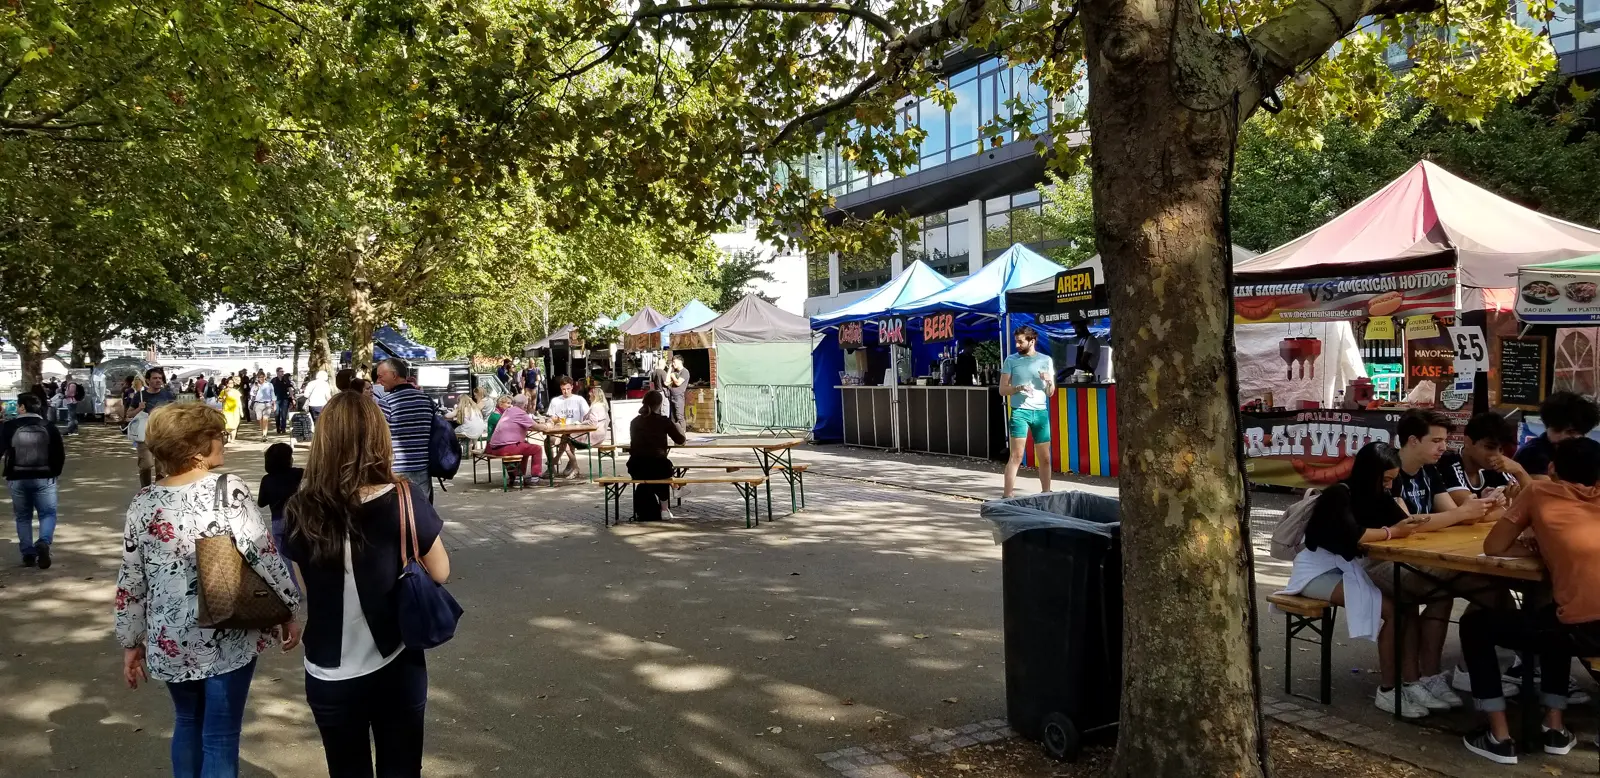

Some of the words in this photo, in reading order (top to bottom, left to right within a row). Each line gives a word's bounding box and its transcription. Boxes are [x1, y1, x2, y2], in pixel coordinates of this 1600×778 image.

[1057, 273, 1092, 294] AREPA
[1255, 283, 1305, 297] SAUSAGE
[1307, 285, 1335, 302] VS
[1337, 276, 1397, 293] AMERICAN
[1400, 272, 1449, 290] HOTDOG
[1045, 314, 1060, 322] GLUTEN
[1060, 312, 1070, 320] FREE
[1087, 309, 1099, 317] CORN
[1279, 309, 1363, 319] www.thegermansausage.com
[879, 318, 904, 344] BAR
[923, 314, 953, 341] BEER
[1456, 333, 1484, 361] £5
[1297, 412, 1352, 422] GRILLED
